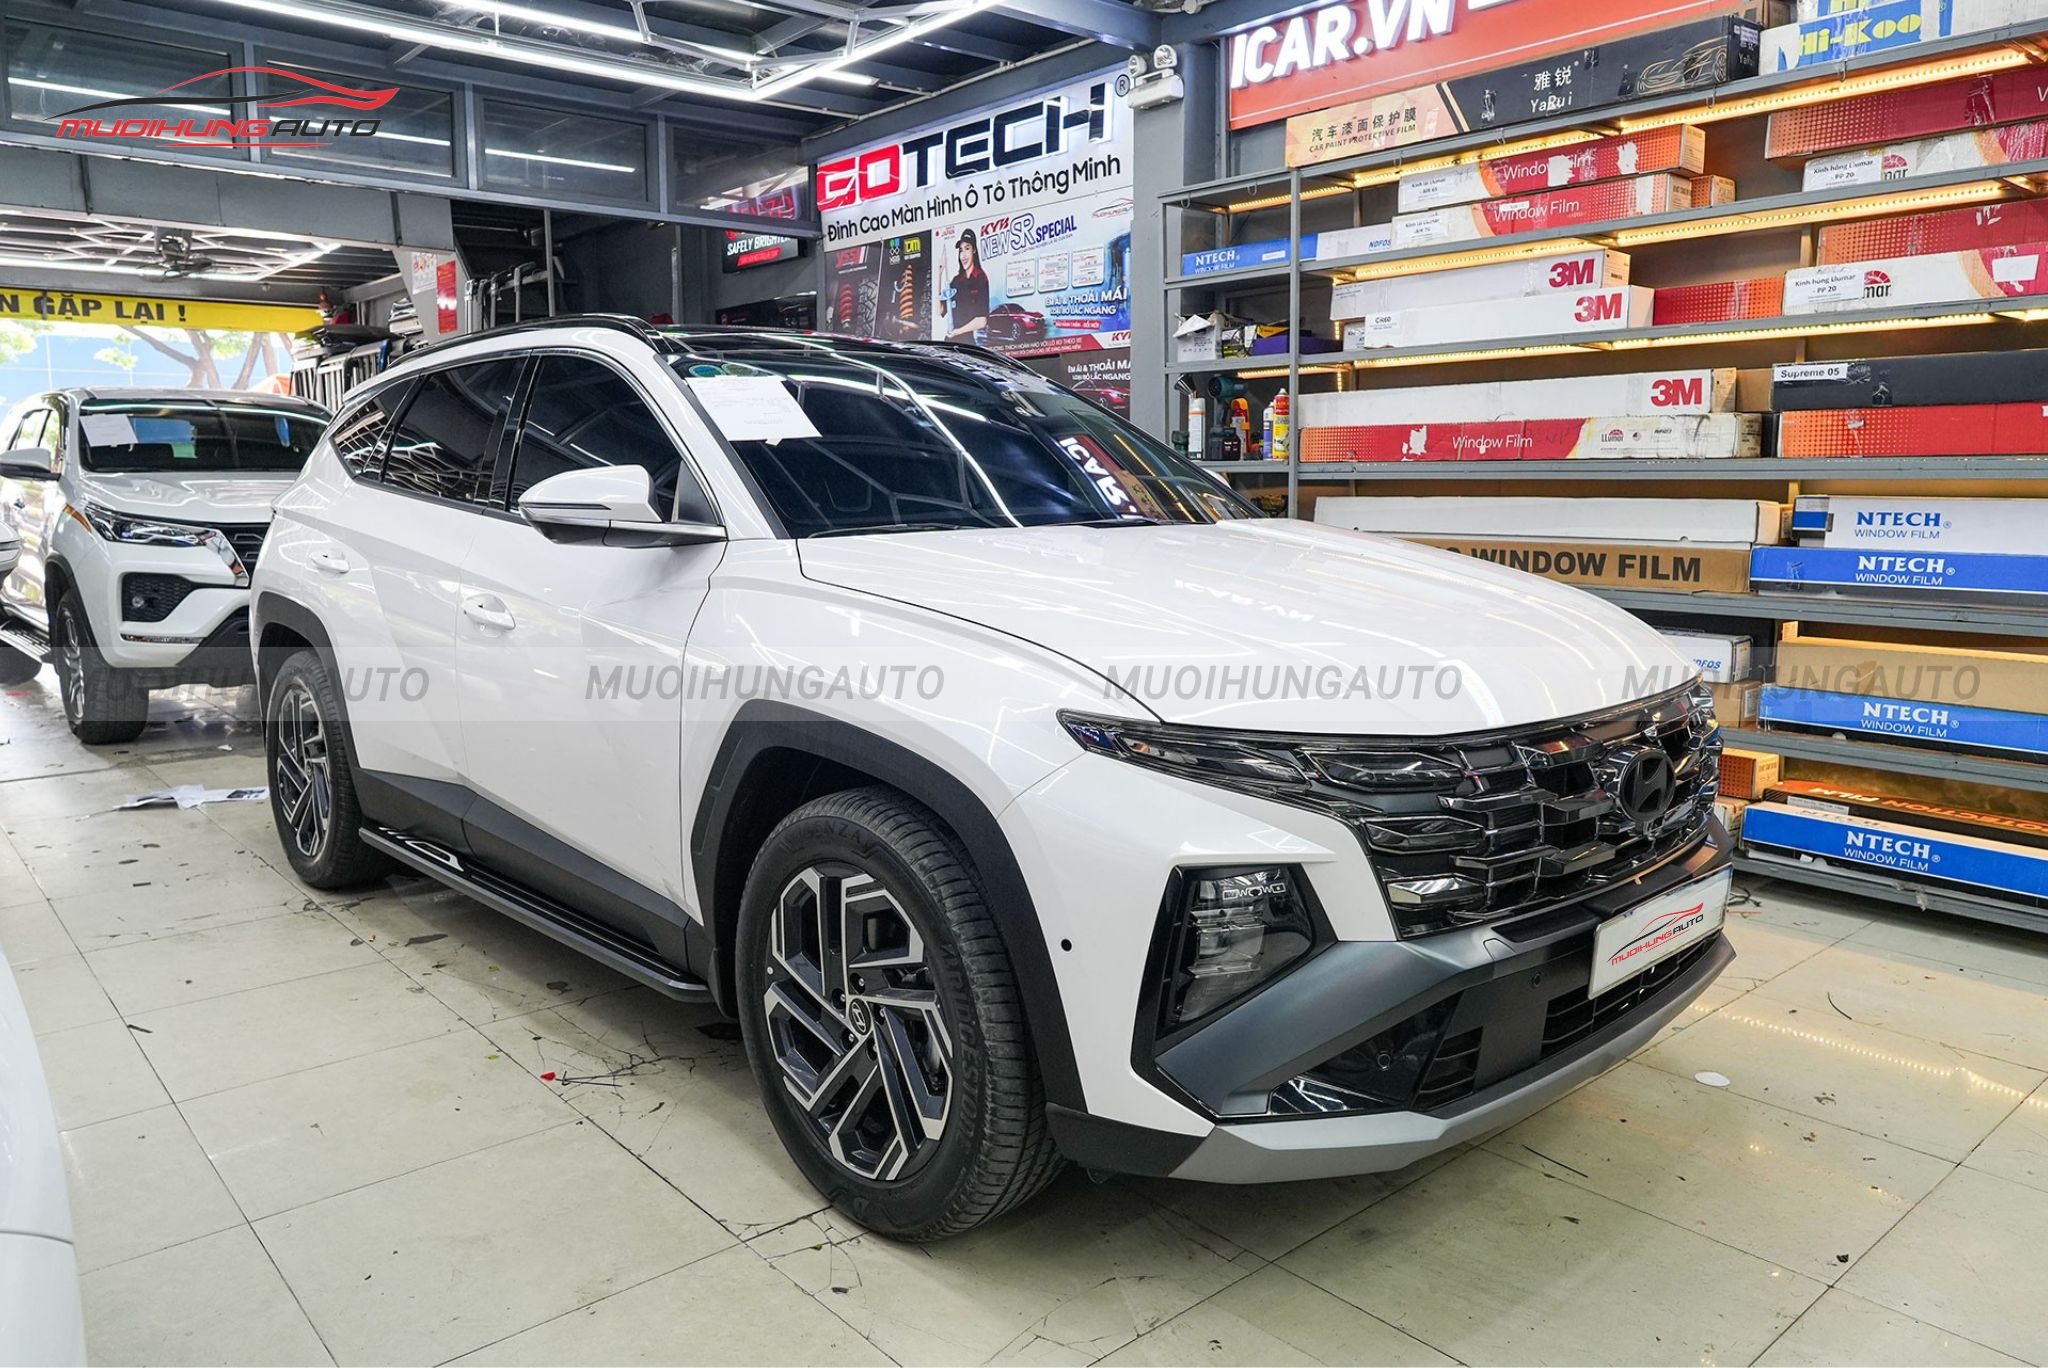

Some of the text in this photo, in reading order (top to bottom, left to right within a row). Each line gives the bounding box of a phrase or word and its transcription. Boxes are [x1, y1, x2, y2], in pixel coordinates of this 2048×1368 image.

[1533, 66, 1573, 92] 雅锐
[1529, 93, 1573, 113] YaRui
[1311, 107, 1417, 142] 汽车漆面保护膜
[817, 83, 1112, 212] GOTECH
[1309, 124, 1416, 153] CAR PAINT PROTECTIVE FILM
[1503, 162, 1549, 181] Windo
[860, 214, 890, 233] Cao
[891, 205, 924, 226] Màn
[927, 194, 962, 219] Hình
[965, 187, 978, 209] Ô
[983, 180, 1005, 202] Tô
[1009, 164, 1069, 193] Thông
[1073, 154, 1121, 180] Minh
[1494, 200, 1580, 223] Window Film
[980, 217, 1009, 237] KYB
[980, 231, 1010, 261] NEW
[1009, 212, 1036, 250] SR
[1035, 215, 1077, 243] SPECIAL
[727, 238, 753, 256] SAFELY
[1195, 250, 1235, 266] NTECH
[1220, 262, 1235, 271] FILM
[1549, 258, 1595, 288] 3M
[1101, 286, 1127, 301] MÁI
[33, 292, 102, 322] GẶP
[115, 300, 164, 325] LẠI
[1084, 304, 1116, 314] NGANG
[1574, 293, 1622, 323] 3M
[1103, 373, 1131, 381] NGANG
[1780, 367, 1840, 380] Supreme 05
[1651, 378, 1703, 407] 3M
[1452, 434, 1533, 450] Window Film
[1857, 512, 1941, 527] NTECH
[1854, 529, 1940, 539] WINDOW FILM
[1618, 553, 1701, 582] FILM
[1858, 555, 1945, 573] NTECH
[1855, 573, 1943, 586] WINDOW FILM
[1693, 658, 1721, 669] OFOS
[1863, 702, 1949, 726] NTECH
[1861, 719, 1947, 738] WINDOW FILM
[1881, 800, 2048, 833] OTECTION
[1846, 831, 1931, 860] NTECH
[1844, 848, 1929, 872] WINDOW FILM
[1611, 914, 1704, 966] MUOIHUNGAUTO
